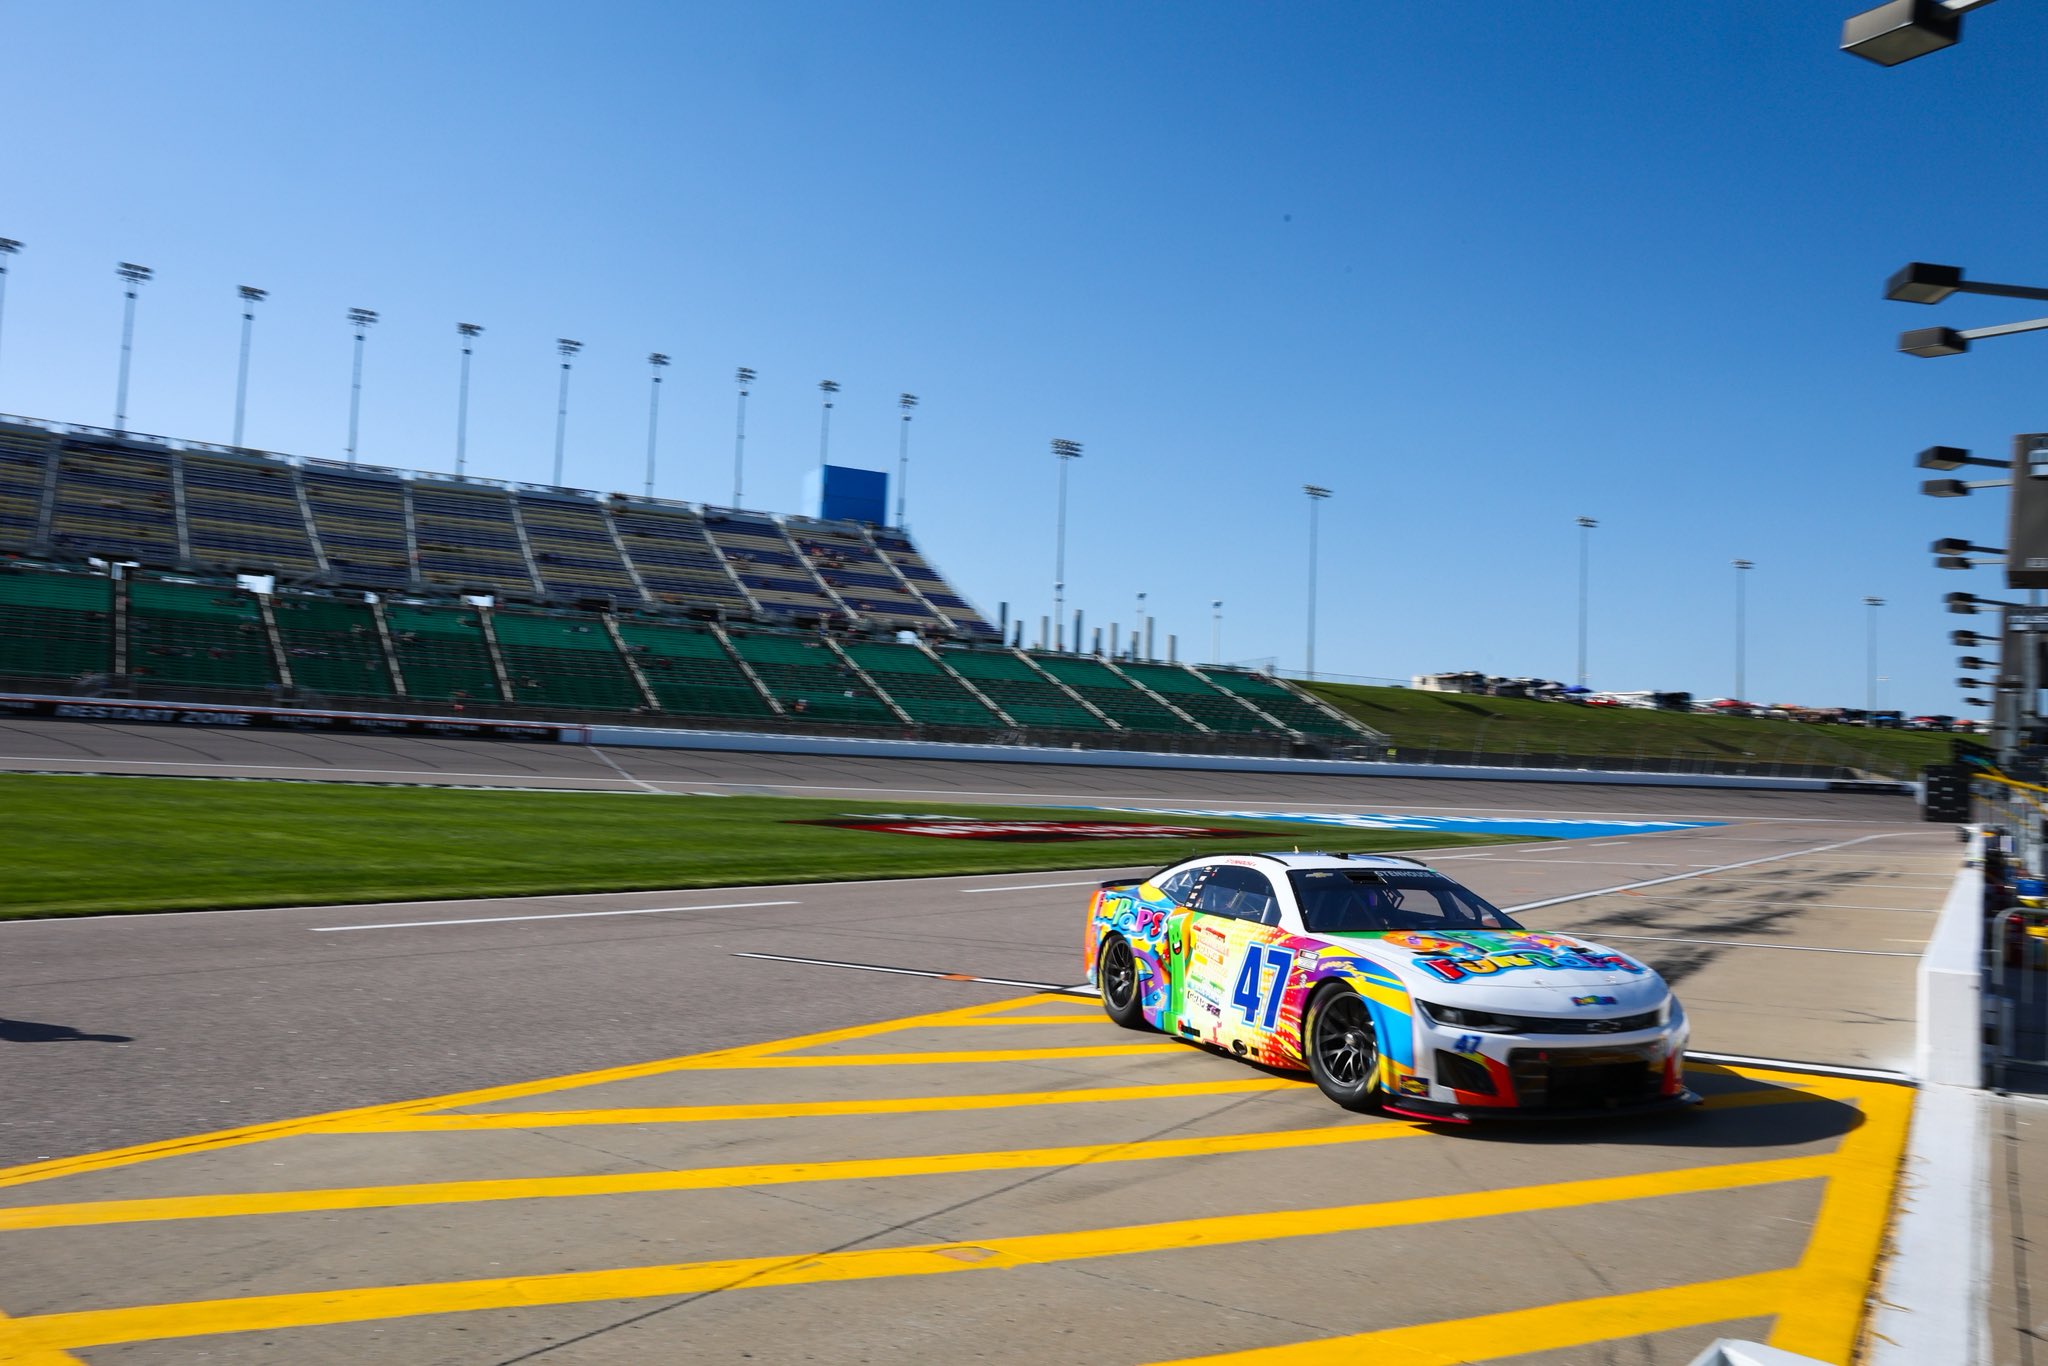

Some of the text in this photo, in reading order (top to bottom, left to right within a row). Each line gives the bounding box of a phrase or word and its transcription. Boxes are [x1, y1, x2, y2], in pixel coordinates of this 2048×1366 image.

[54, 704, 178, 722] RESTART
[179, 711, 253, 726] ZONE
[1231, 941, 1296, 1033] 47
[1453, 1034, 1482, 1053] 47
